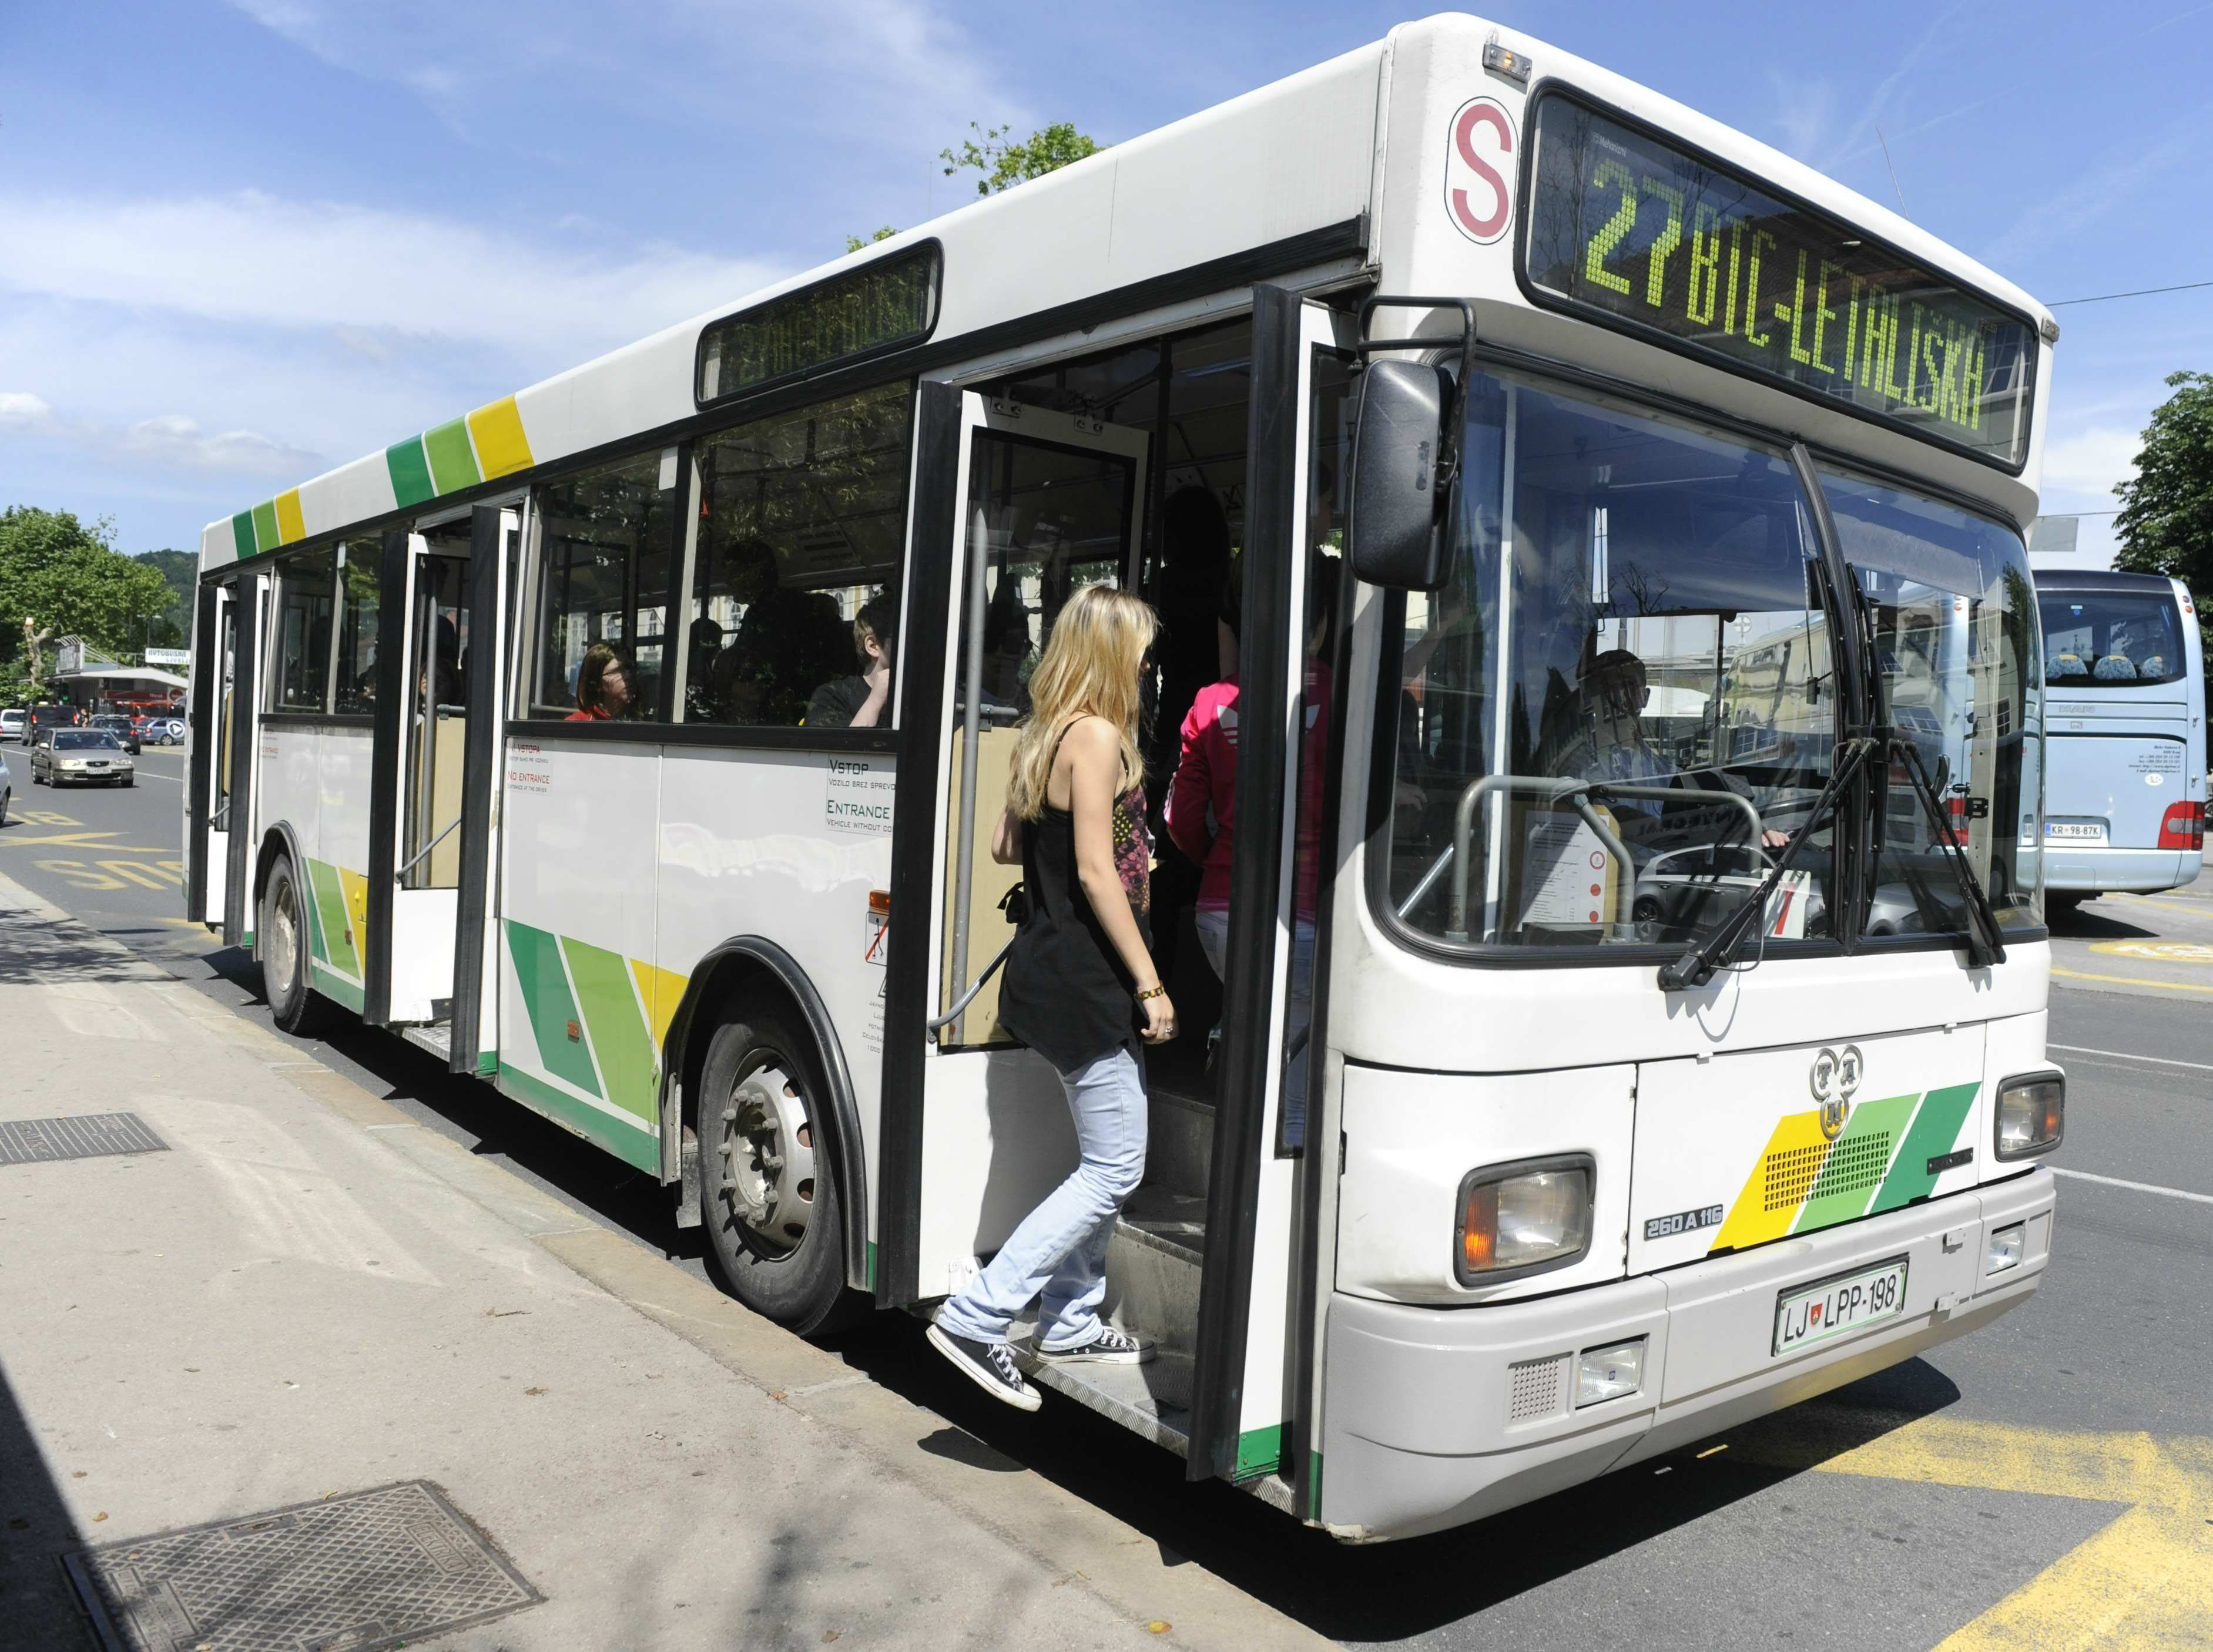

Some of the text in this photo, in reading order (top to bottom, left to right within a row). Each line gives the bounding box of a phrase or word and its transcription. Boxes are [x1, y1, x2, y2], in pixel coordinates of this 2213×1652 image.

[1453, 103, 1511, 237] S
[1586, 158, 1684, 308] 27
[830, 759, 869, 775] VSTOP
[508, 770, 550, 784] NO ENTRANCE
[829, 778, 850, 787] VOZILO
[827, 800, 890, 819] ENTRANCE
[827, 818, 851, 828] VEHICLE
[853, 822, 880, 831] WITHOUT
[2052, 826, 2063, 834] KR
[2070, 826, 2098, 835] 98-87K
[867, 1045, 880, 1053] 1000
[1647, 1206, 1722, 1238] 260 A 116
[1784, 1274, 1897, 1342] LJ LPP-198
